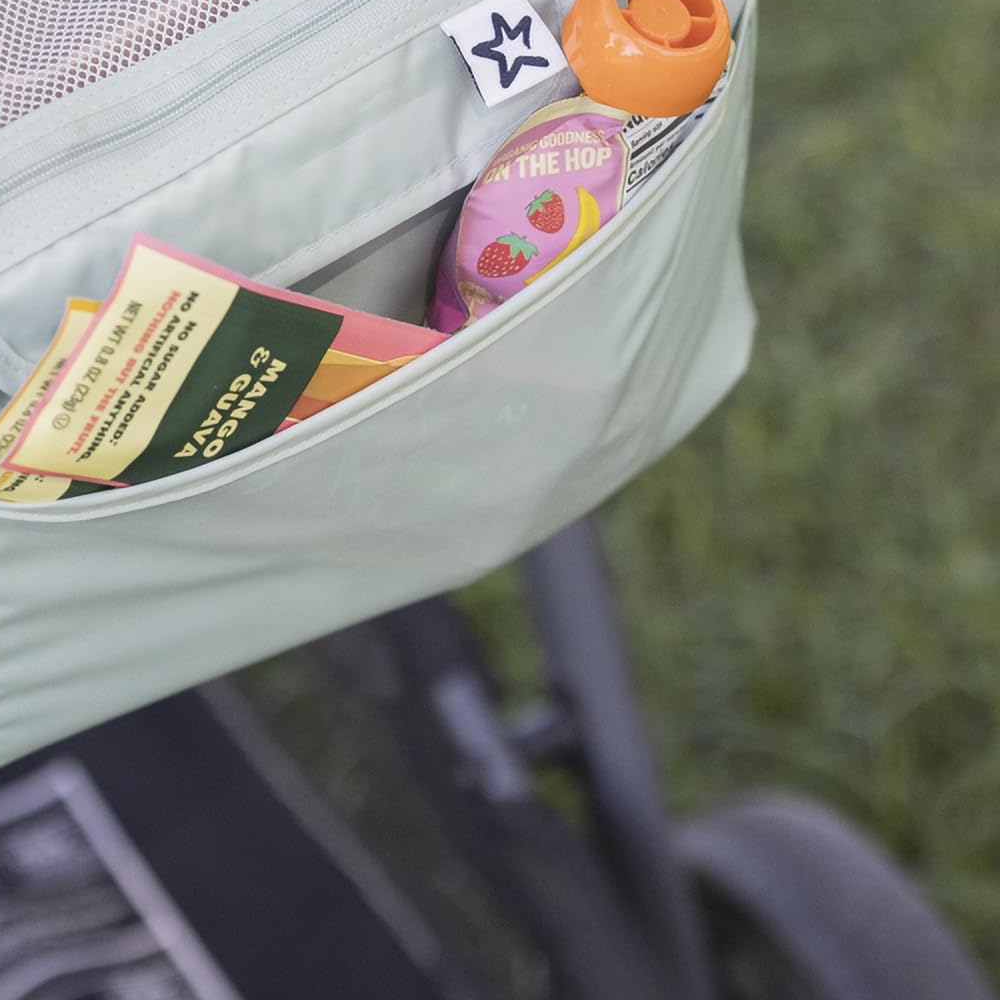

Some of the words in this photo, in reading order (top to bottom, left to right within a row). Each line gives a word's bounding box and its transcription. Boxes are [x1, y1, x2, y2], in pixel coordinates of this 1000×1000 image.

[515, 151, 560, 178] THE
[564, 147, 612, 172] HOP
[120, 300, 143, 324] NET
[179, 291, 199, 312] NO
[107, 325, 129, 346] WT
[133, 290, 181, 353] NOTHING
[176, 320, 198, 341] NO
[129, 314, 181, 386] ARTIFICIAL
[249, 347, 269, 368] &
[114, 357, 137, 385] BUT
[143, 344, 179, 392] SUGAR
[94, 388, 118, 413] THE
[172, 375, 252, 457] GUAVA
[202, 358, 287, 457] MANGO
[74, 389, 131, 463] ANYTHING.
[108, 394, 146, 446] ADDED:
